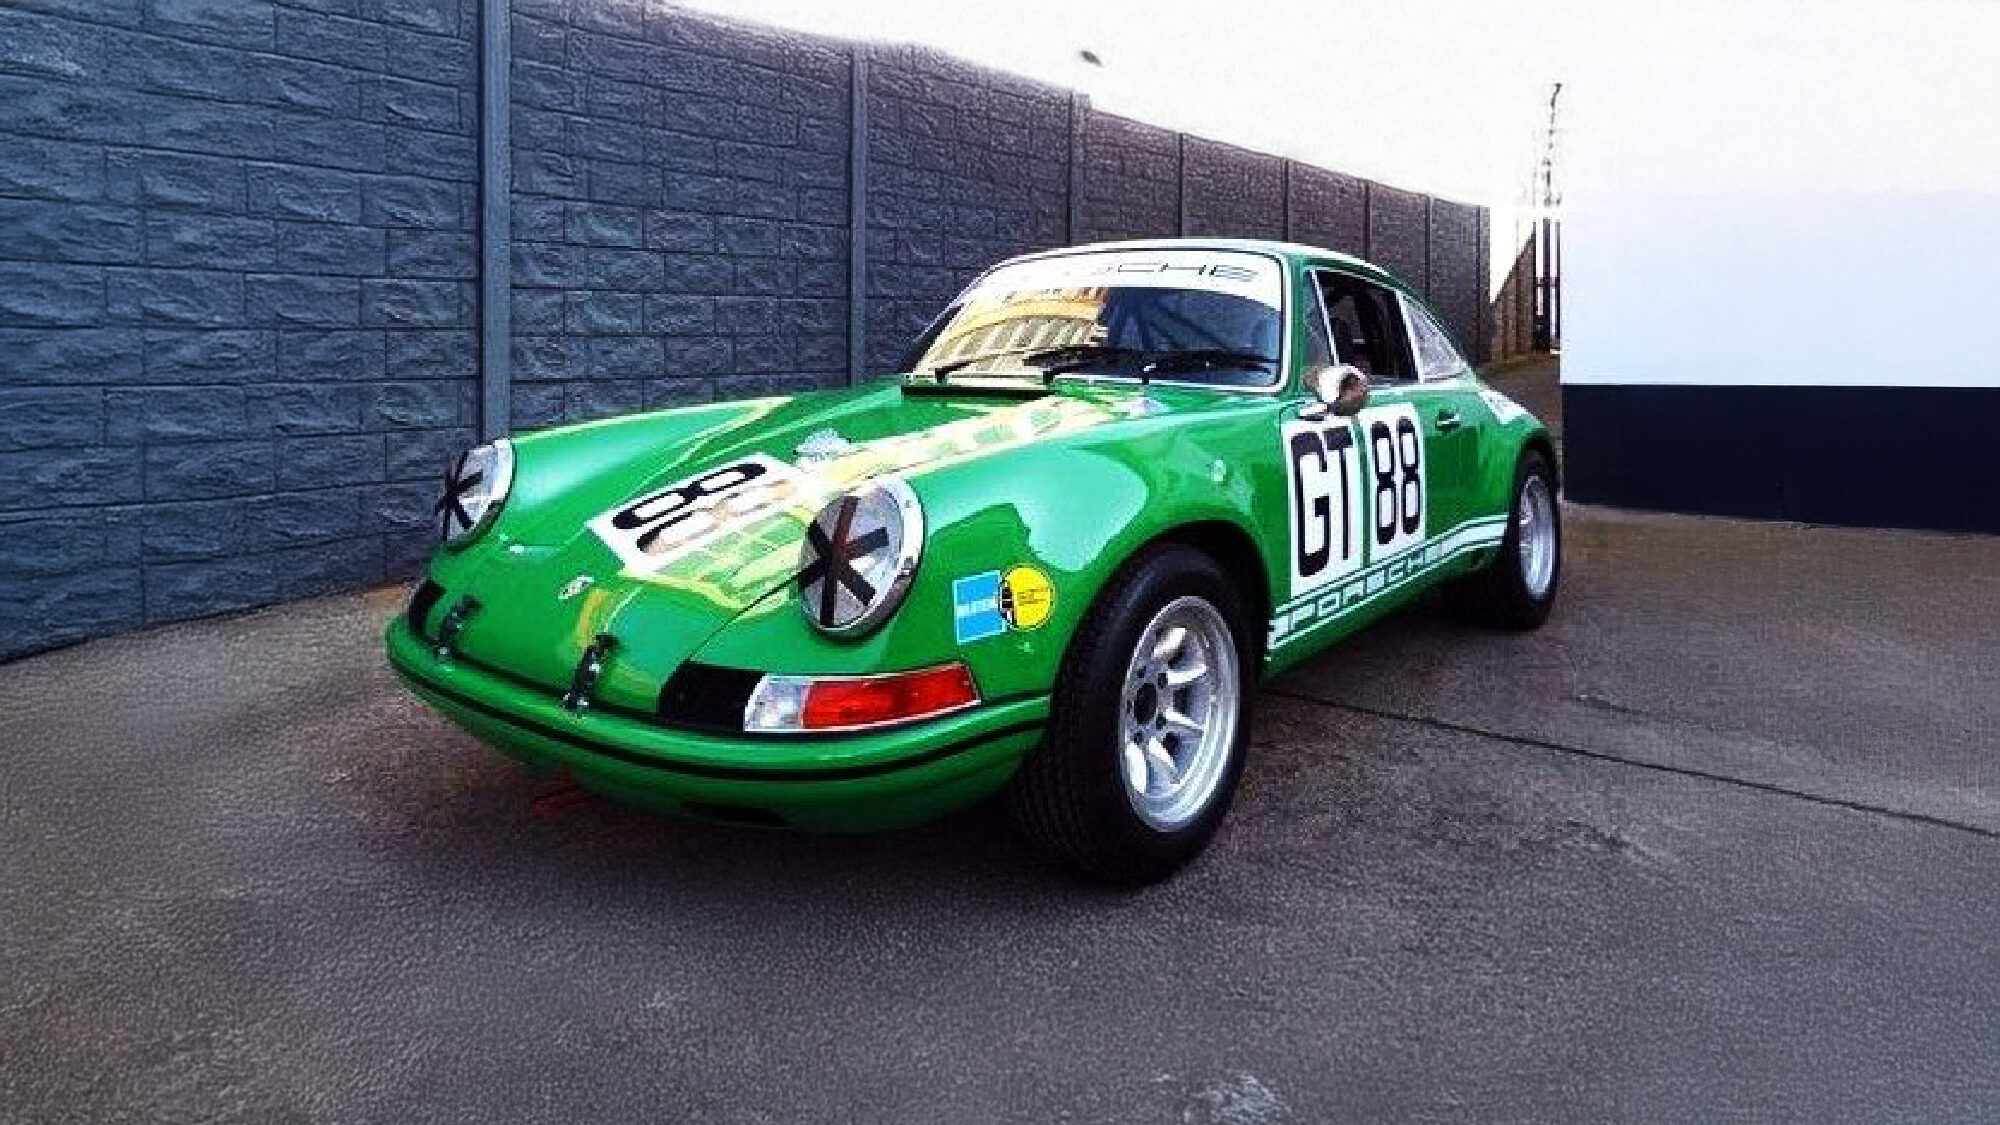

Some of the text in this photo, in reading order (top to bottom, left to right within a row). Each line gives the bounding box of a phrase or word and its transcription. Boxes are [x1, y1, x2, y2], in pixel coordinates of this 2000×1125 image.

[1291, 416, 1420, 578] GT 88
[1292, 541, 1441, 630] PORCH
